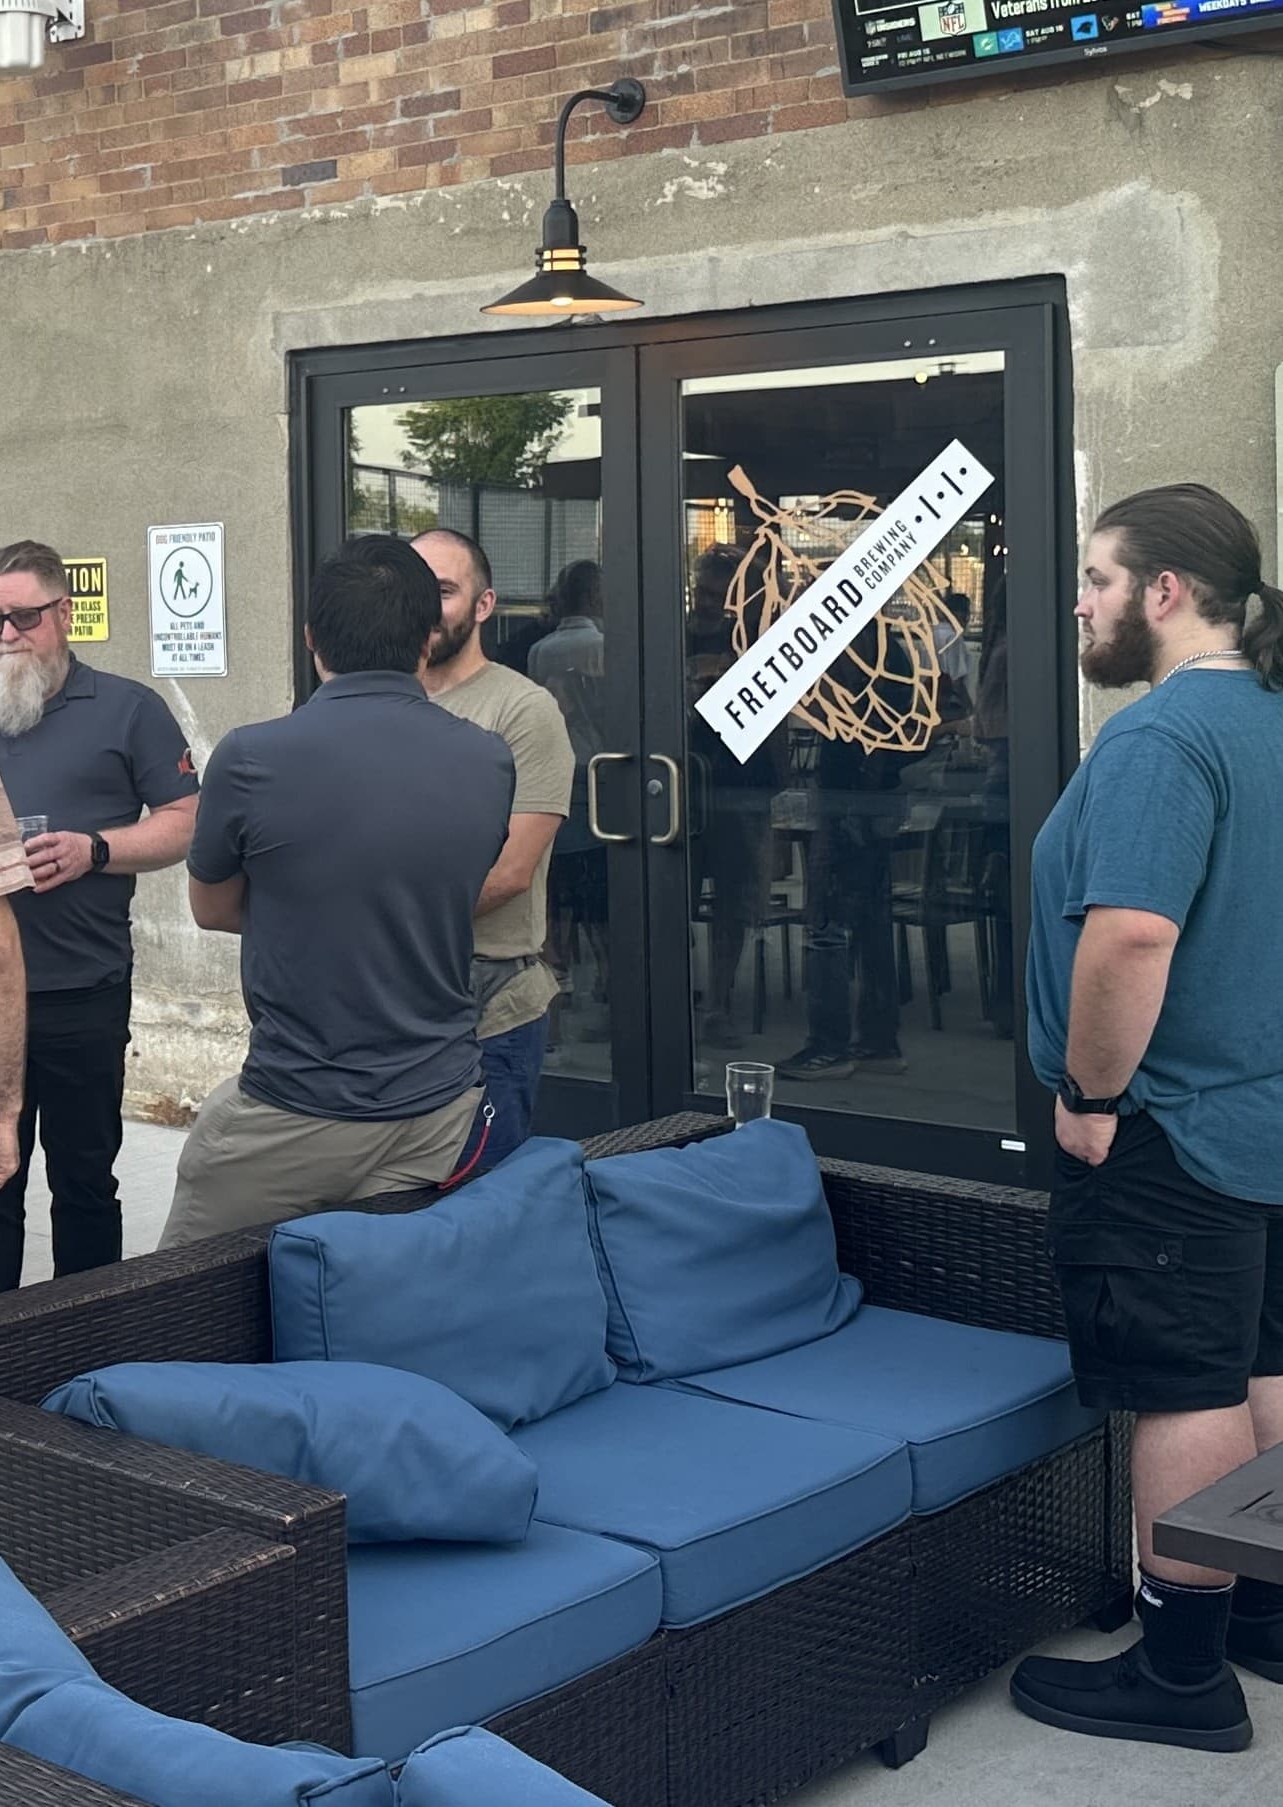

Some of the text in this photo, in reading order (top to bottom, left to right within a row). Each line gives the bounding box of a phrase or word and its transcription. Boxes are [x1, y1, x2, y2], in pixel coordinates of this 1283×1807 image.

[991, 0, 1048, 19] Veterans
[1199, 0, 1247, 13] WEEKDAYS
[942, 15, 965, 32] NFL
[198, 531, 216, 542] PATIO
[852, 519, 908, 578] BREWING
[864, 531, 918, 590] COMPANY
[64, 567, 102, 593] TION
[76, 613, 105, 624] PRESENT
[74, 626, 93, 636] PATIO
[723, 578, 863, 729] FRETBOARD
